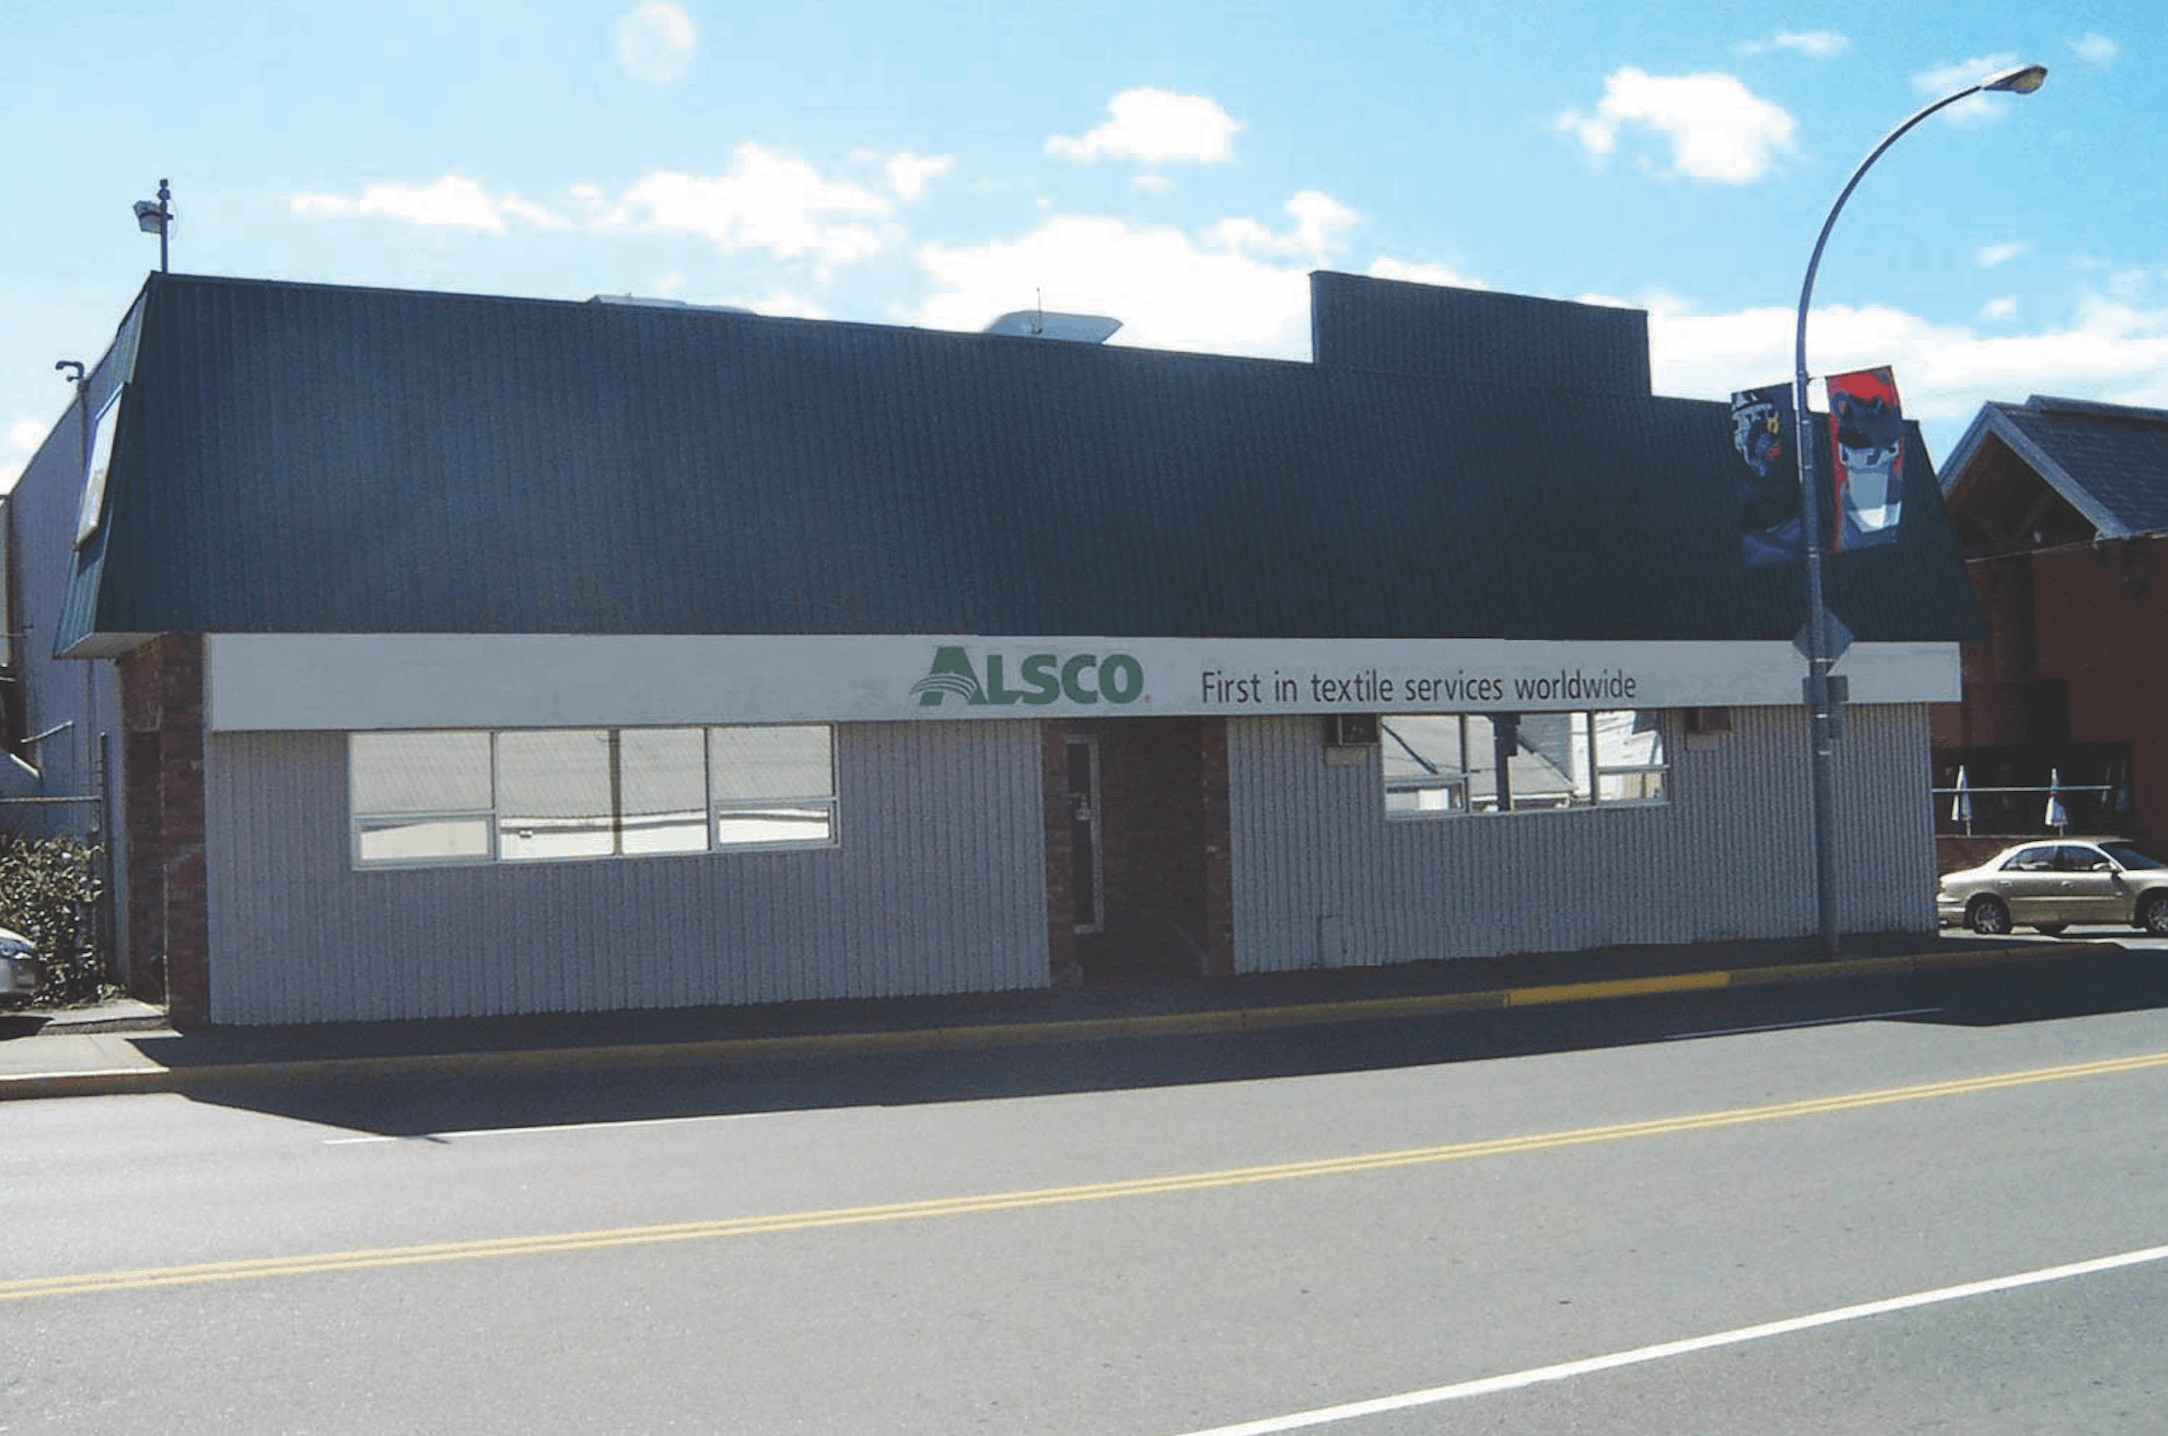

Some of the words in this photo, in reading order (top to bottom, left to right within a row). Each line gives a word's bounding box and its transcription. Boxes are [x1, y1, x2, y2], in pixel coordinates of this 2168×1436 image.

[910, 646, 1145, 706] ALSCO
[1202, 670, 1263, 704] First
[1274, 670, 1298, 703] in
[1310, 669, 1395, 702] textile
[1405, 669, 1504, 702] services
[1514, 668, 1638, 701] worldwide
